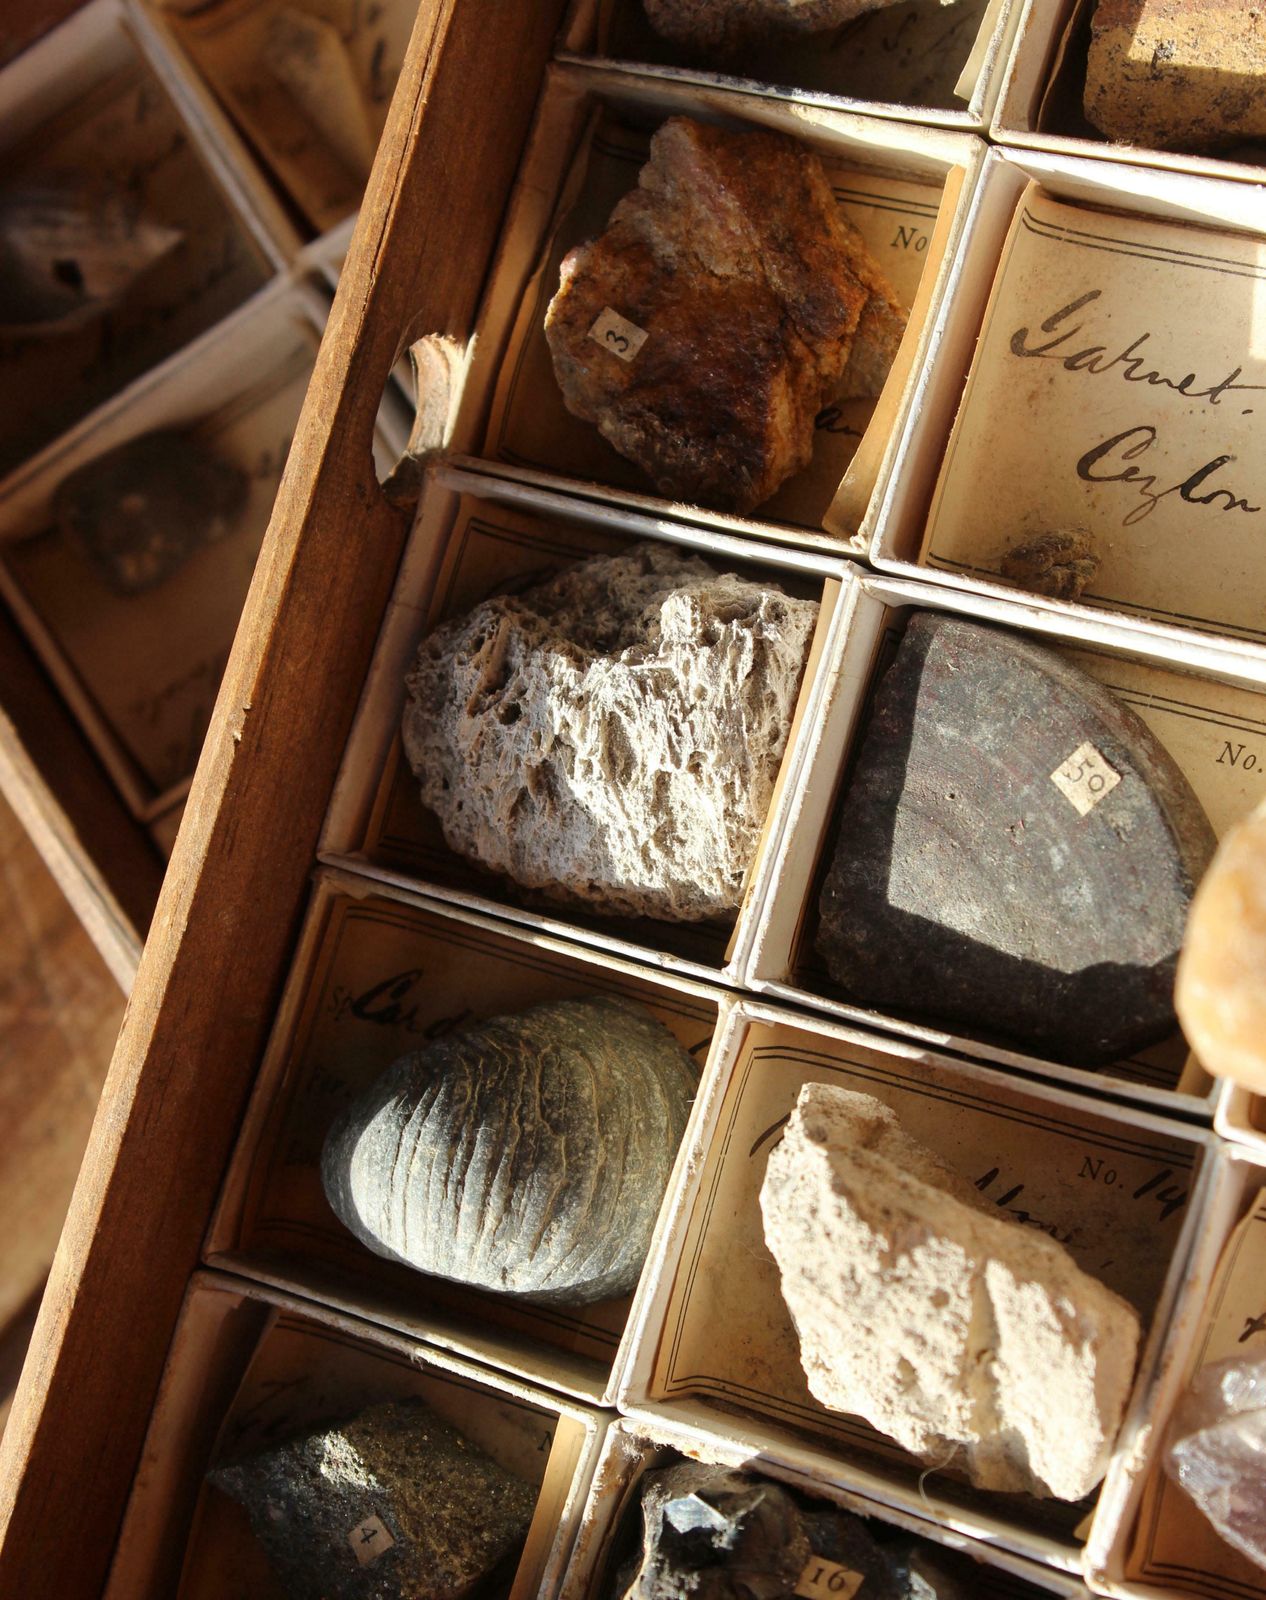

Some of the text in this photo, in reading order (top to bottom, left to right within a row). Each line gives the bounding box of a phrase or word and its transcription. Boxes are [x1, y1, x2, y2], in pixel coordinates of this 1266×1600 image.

[606, 330, 629, 353] 3
[1076, 425, 1261, 527] Ceylon
[1215, 740, 1263, 774] No.
[1062, 758, 1105, 792] 50
[1077, 1156, 1125, 1189] No.
[1132, 1168, 1188, 1222] 14
[360, 1527, 378, 1545] 4
[809, 1566, 849, 1592] 16
